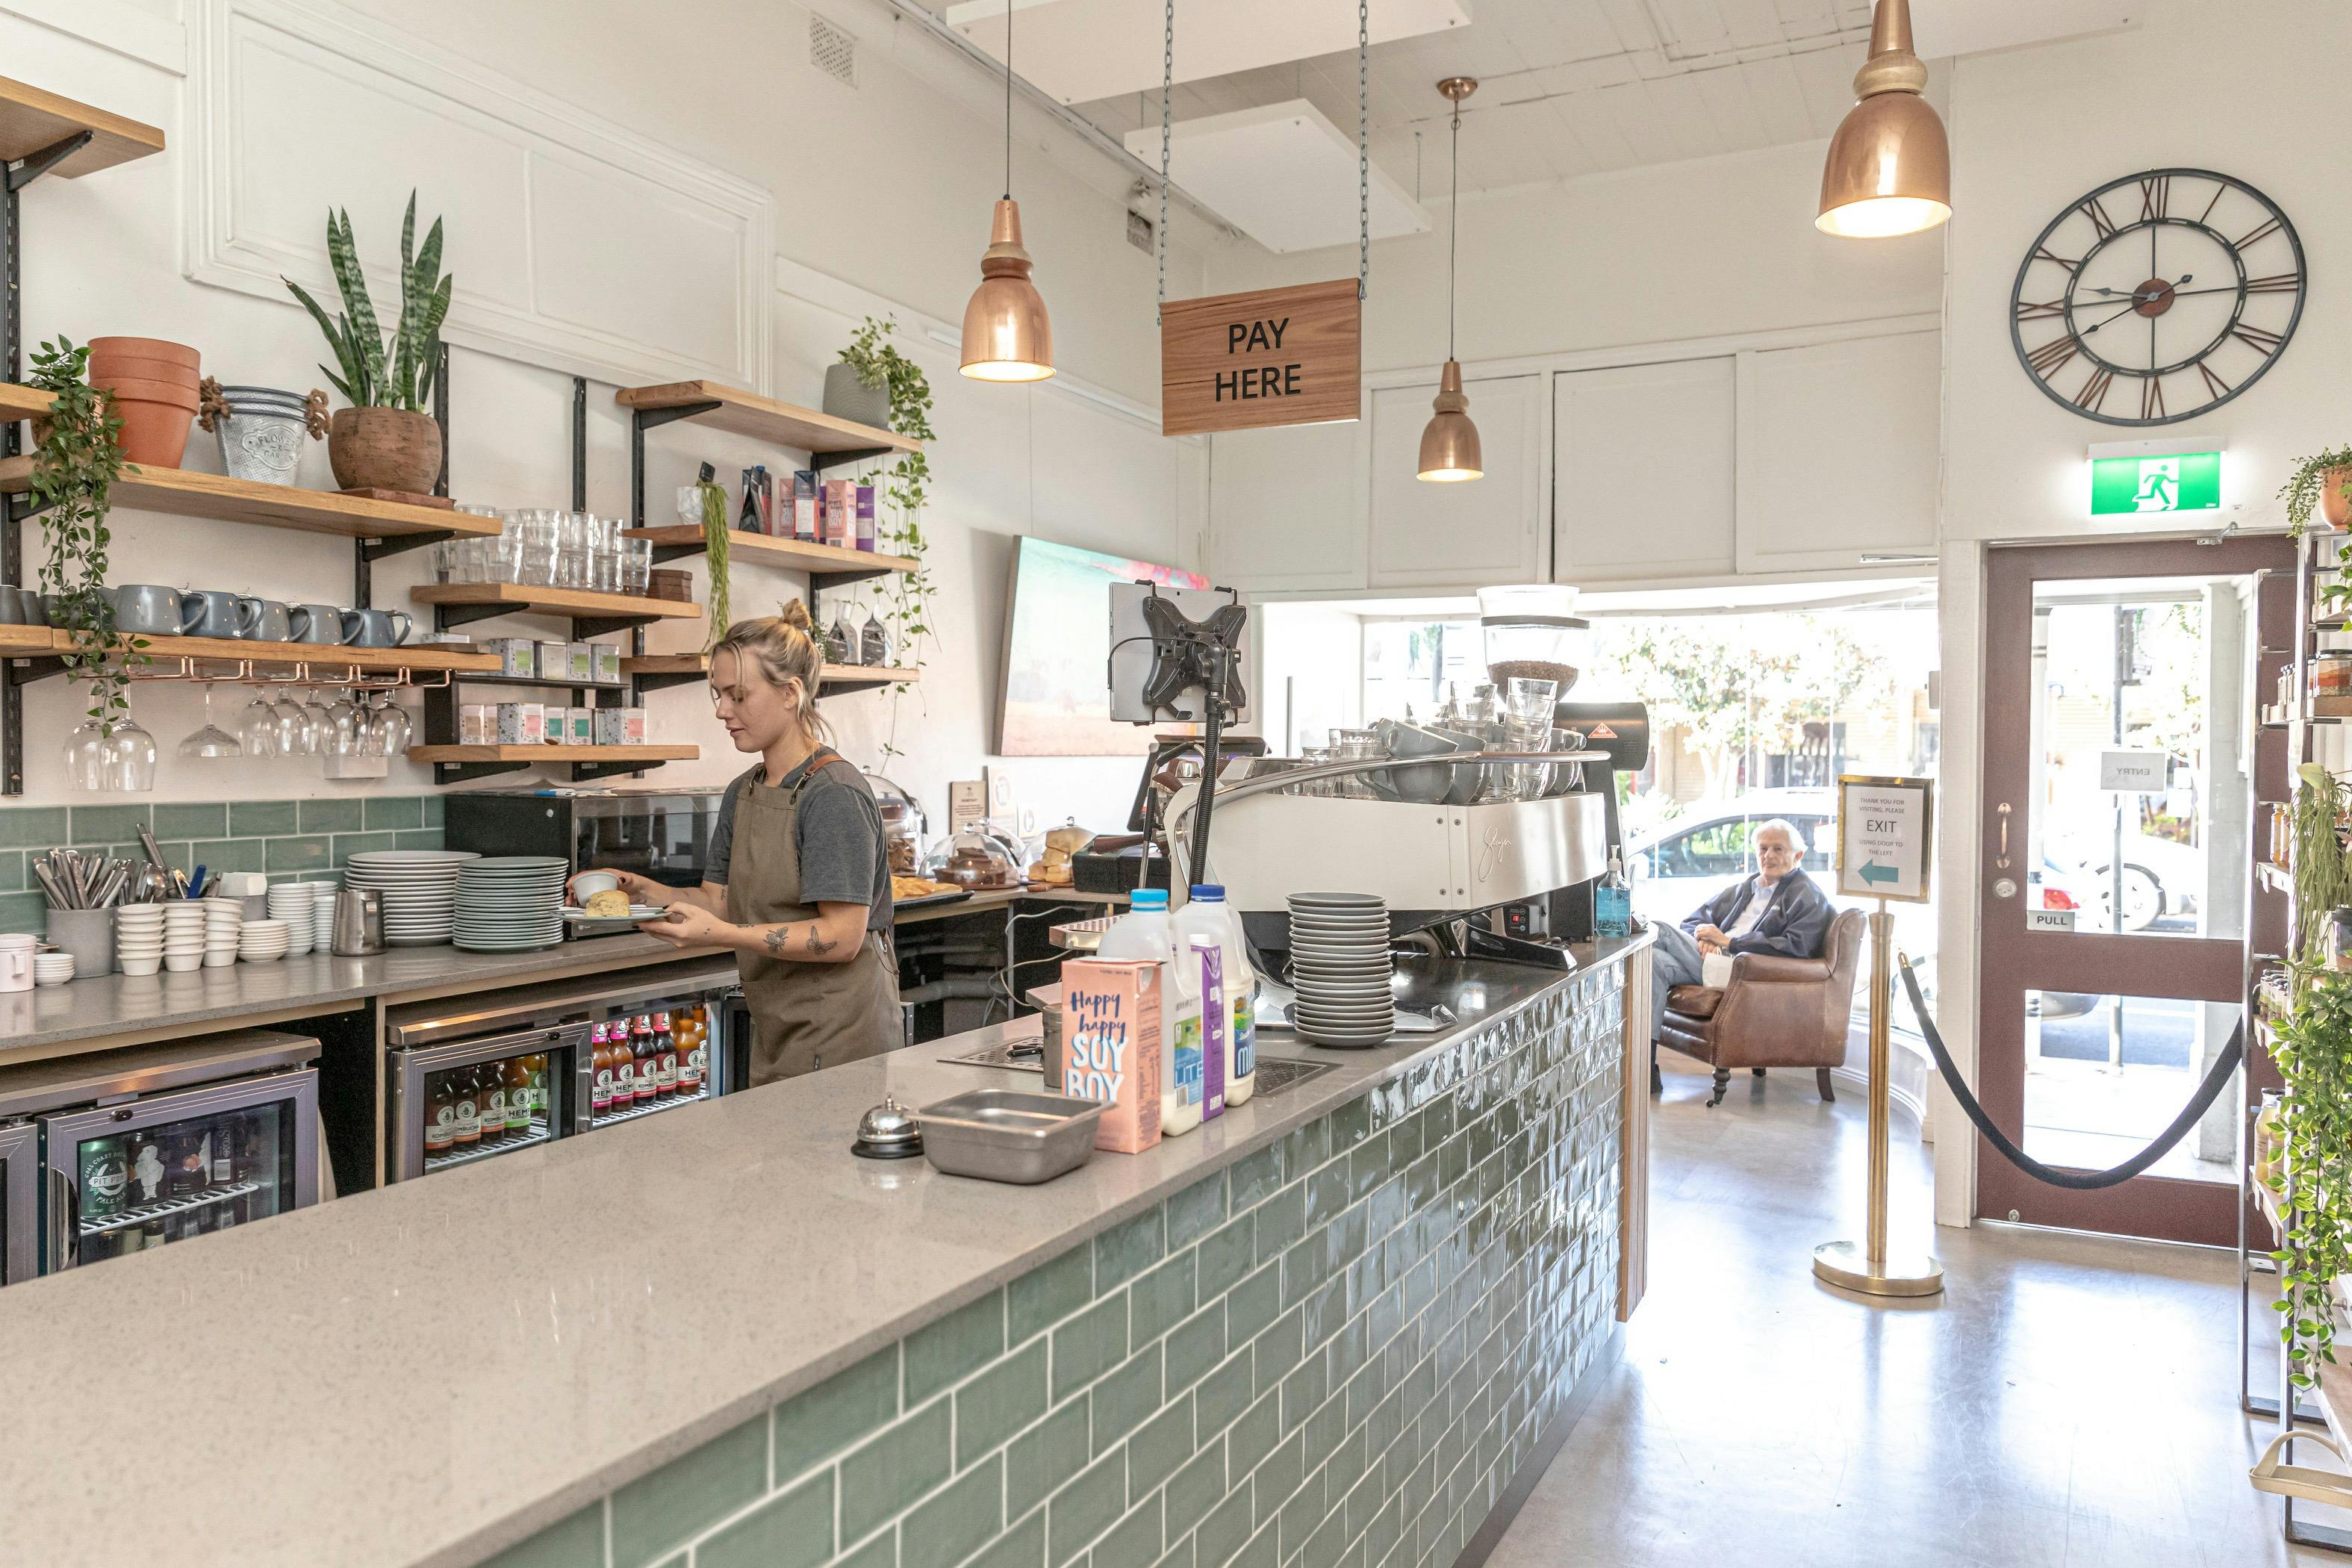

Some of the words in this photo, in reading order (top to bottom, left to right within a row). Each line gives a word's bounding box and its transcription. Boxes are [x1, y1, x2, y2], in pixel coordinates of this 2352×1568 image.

[1228, 317, 1289, 355] PAY
[1215, 364, 1302, 402] HERE
[1867, 819, 1897, 833] EXIT
[2037, 915, 2068, 925] PULL
[1070, 990, 1121, 1018] Happy
[1079, 1014, 1127, 1045] happy
[1071, 1033, 1129, 1073] SOY
[1065, 1068, 1124, 1103] BOY
[93, 1177, 107, 1186] PIT
[96, 1196, 114, 1204] PALE
